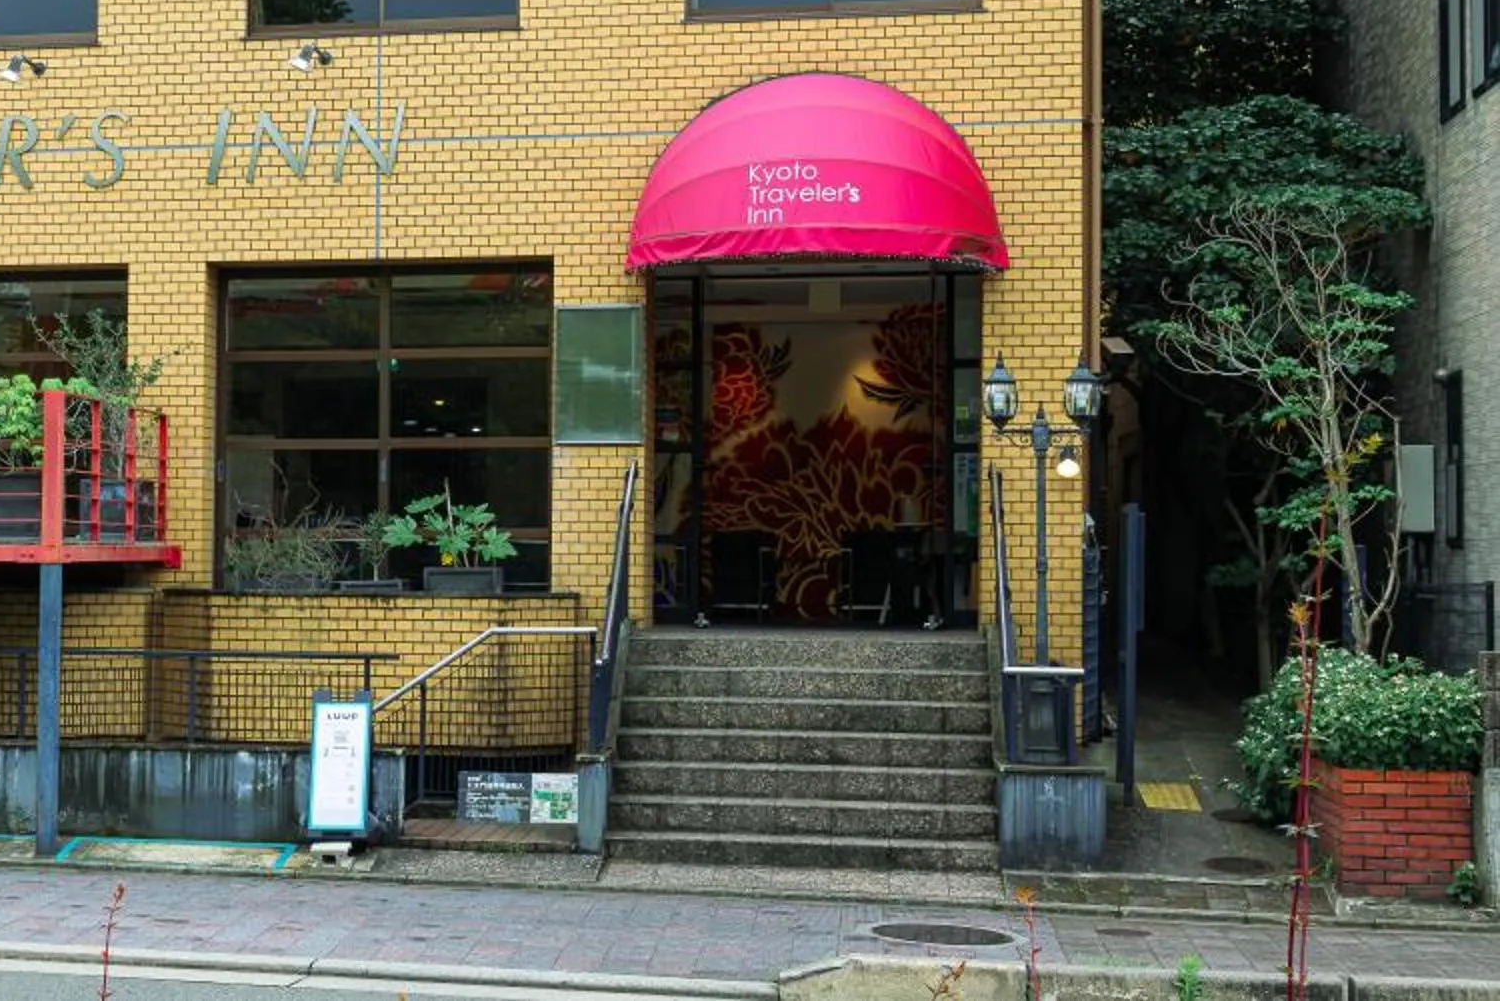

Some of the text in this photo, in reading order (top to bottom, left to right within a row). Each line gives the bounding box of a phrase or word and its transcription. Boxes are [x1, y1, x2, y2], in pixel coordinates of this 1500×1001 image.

[206, 102, 405, 185] INN
[749, 161, 818, 186] Kyoto
[749, 182, 861, 204] Traveler's
[747, 206, 783, 224] Inn
